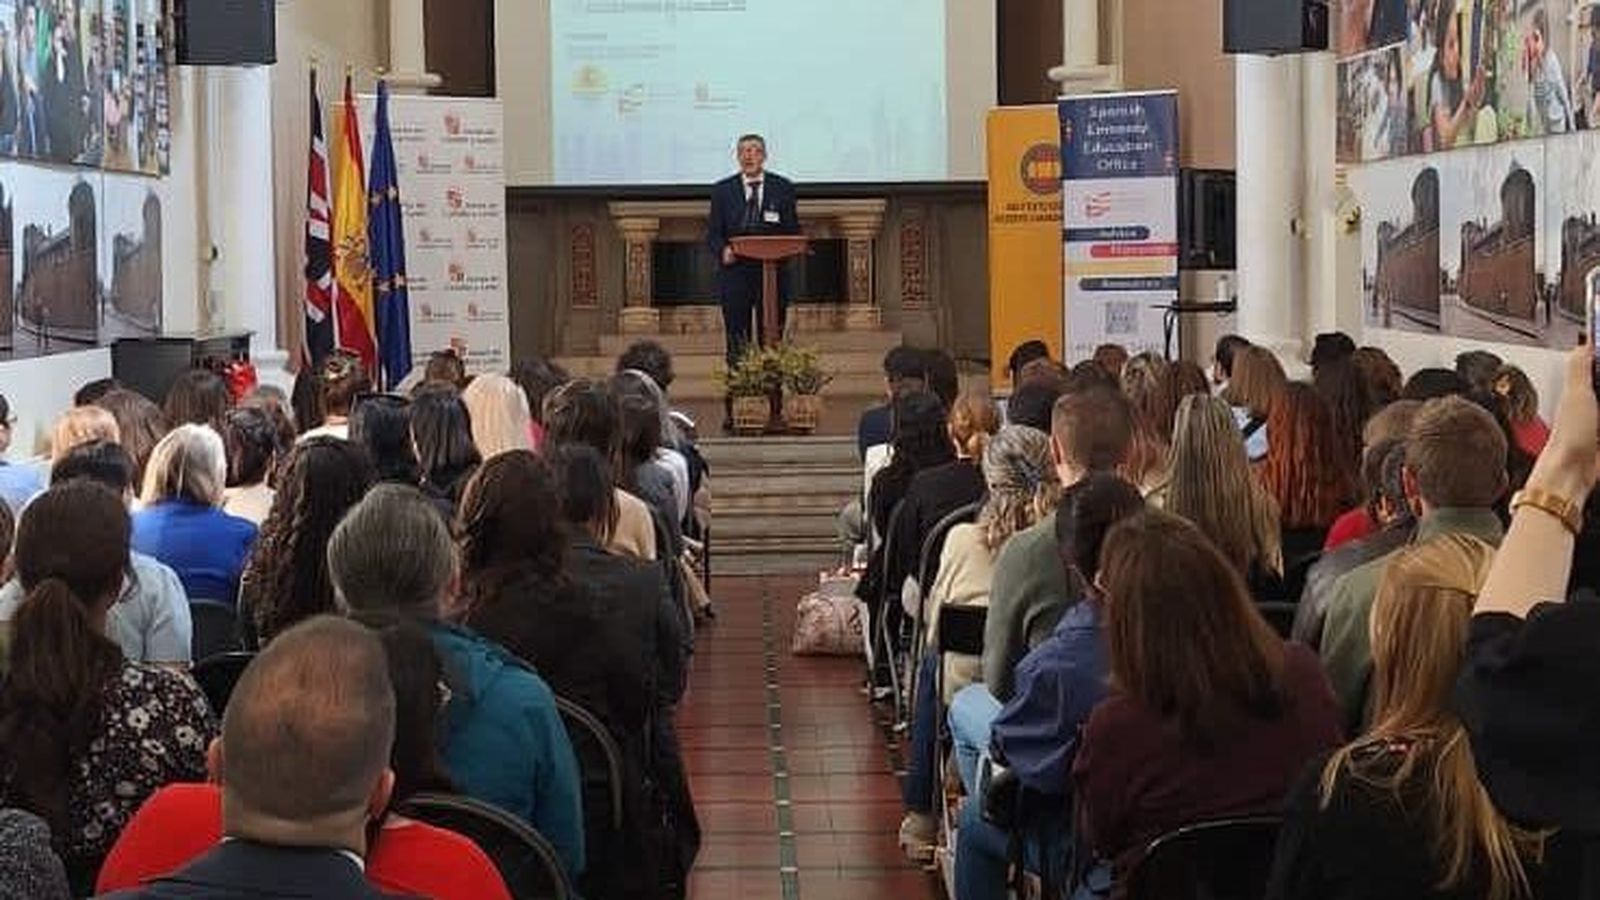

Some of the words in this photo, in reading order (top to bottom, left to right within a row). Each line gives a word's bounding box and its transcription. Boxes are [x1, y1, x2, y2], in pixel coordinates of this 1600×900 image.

[1088, 104, 1145, 121] Spanish
[1083, 140, 1154, 154] Education
[1096, 159, 1138, 171] Office
